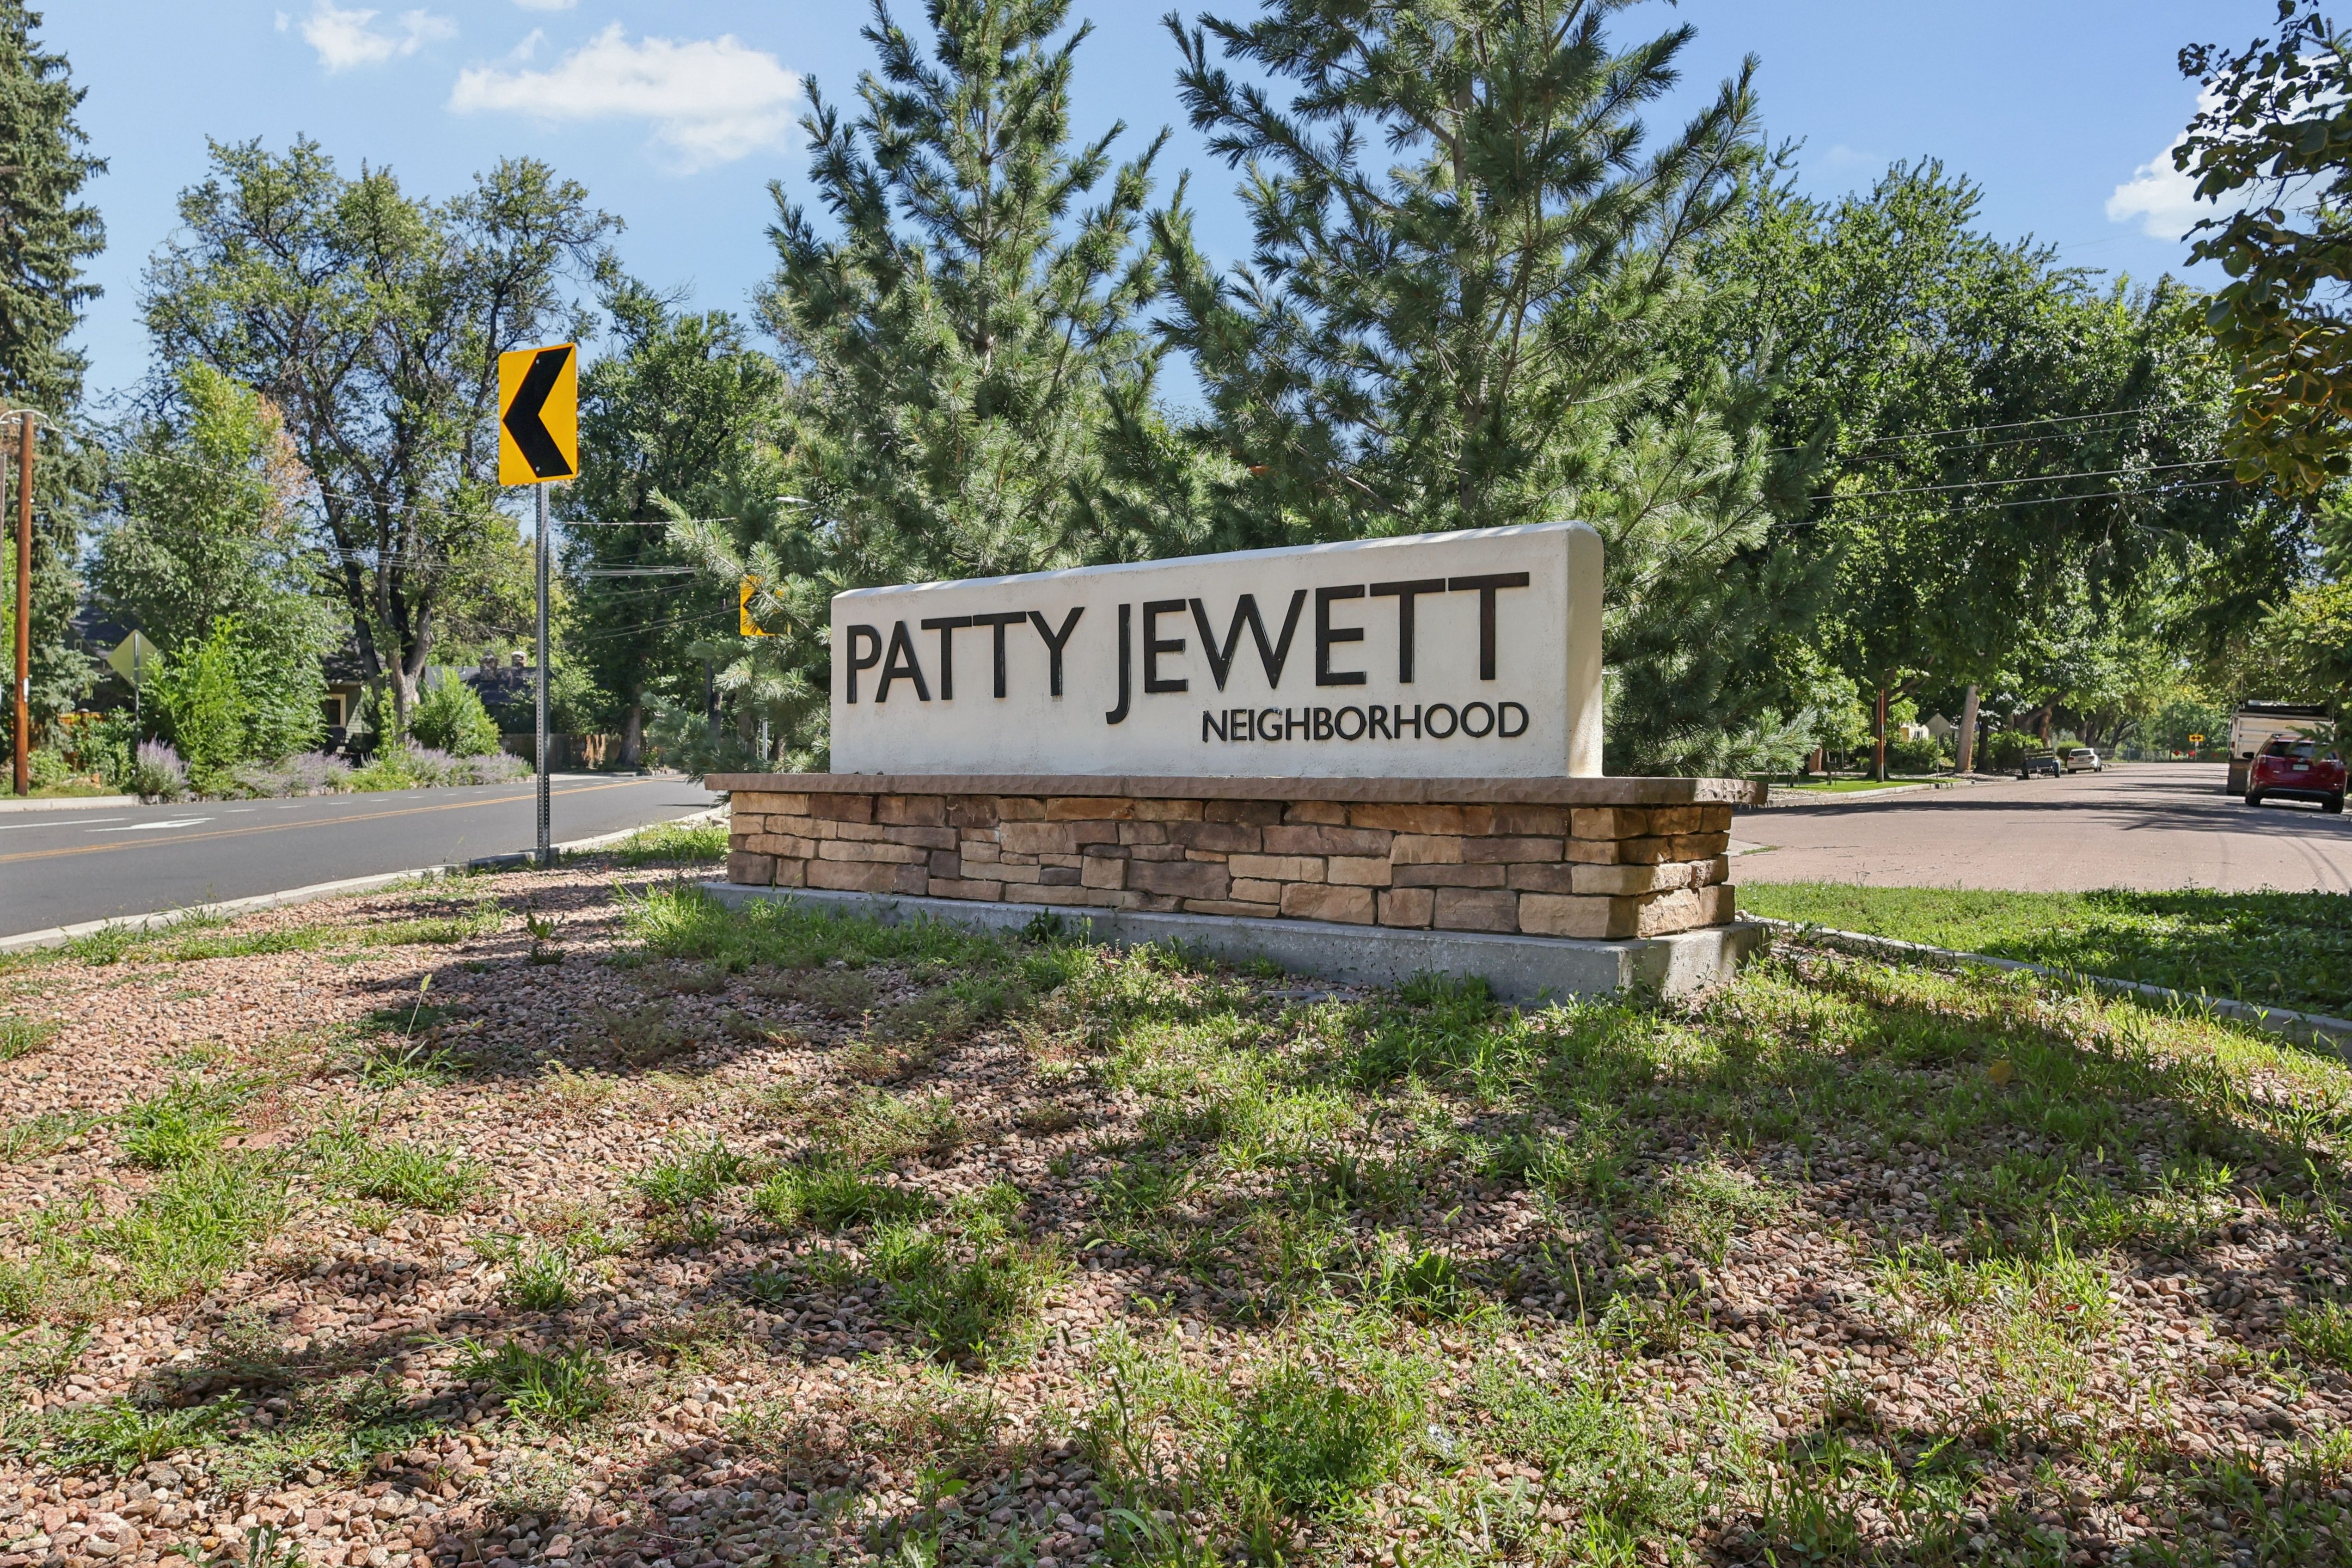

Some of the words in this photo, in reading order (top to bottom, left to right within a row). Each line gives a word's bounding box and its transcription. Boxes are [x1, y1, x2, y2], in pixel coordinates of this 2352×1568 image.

[846, 606, 1085, 704] PATTY
[1105, 571, 1530, 725] JEWETT
[1202, 701, 1530, 743] NEIGHBORHOOD
